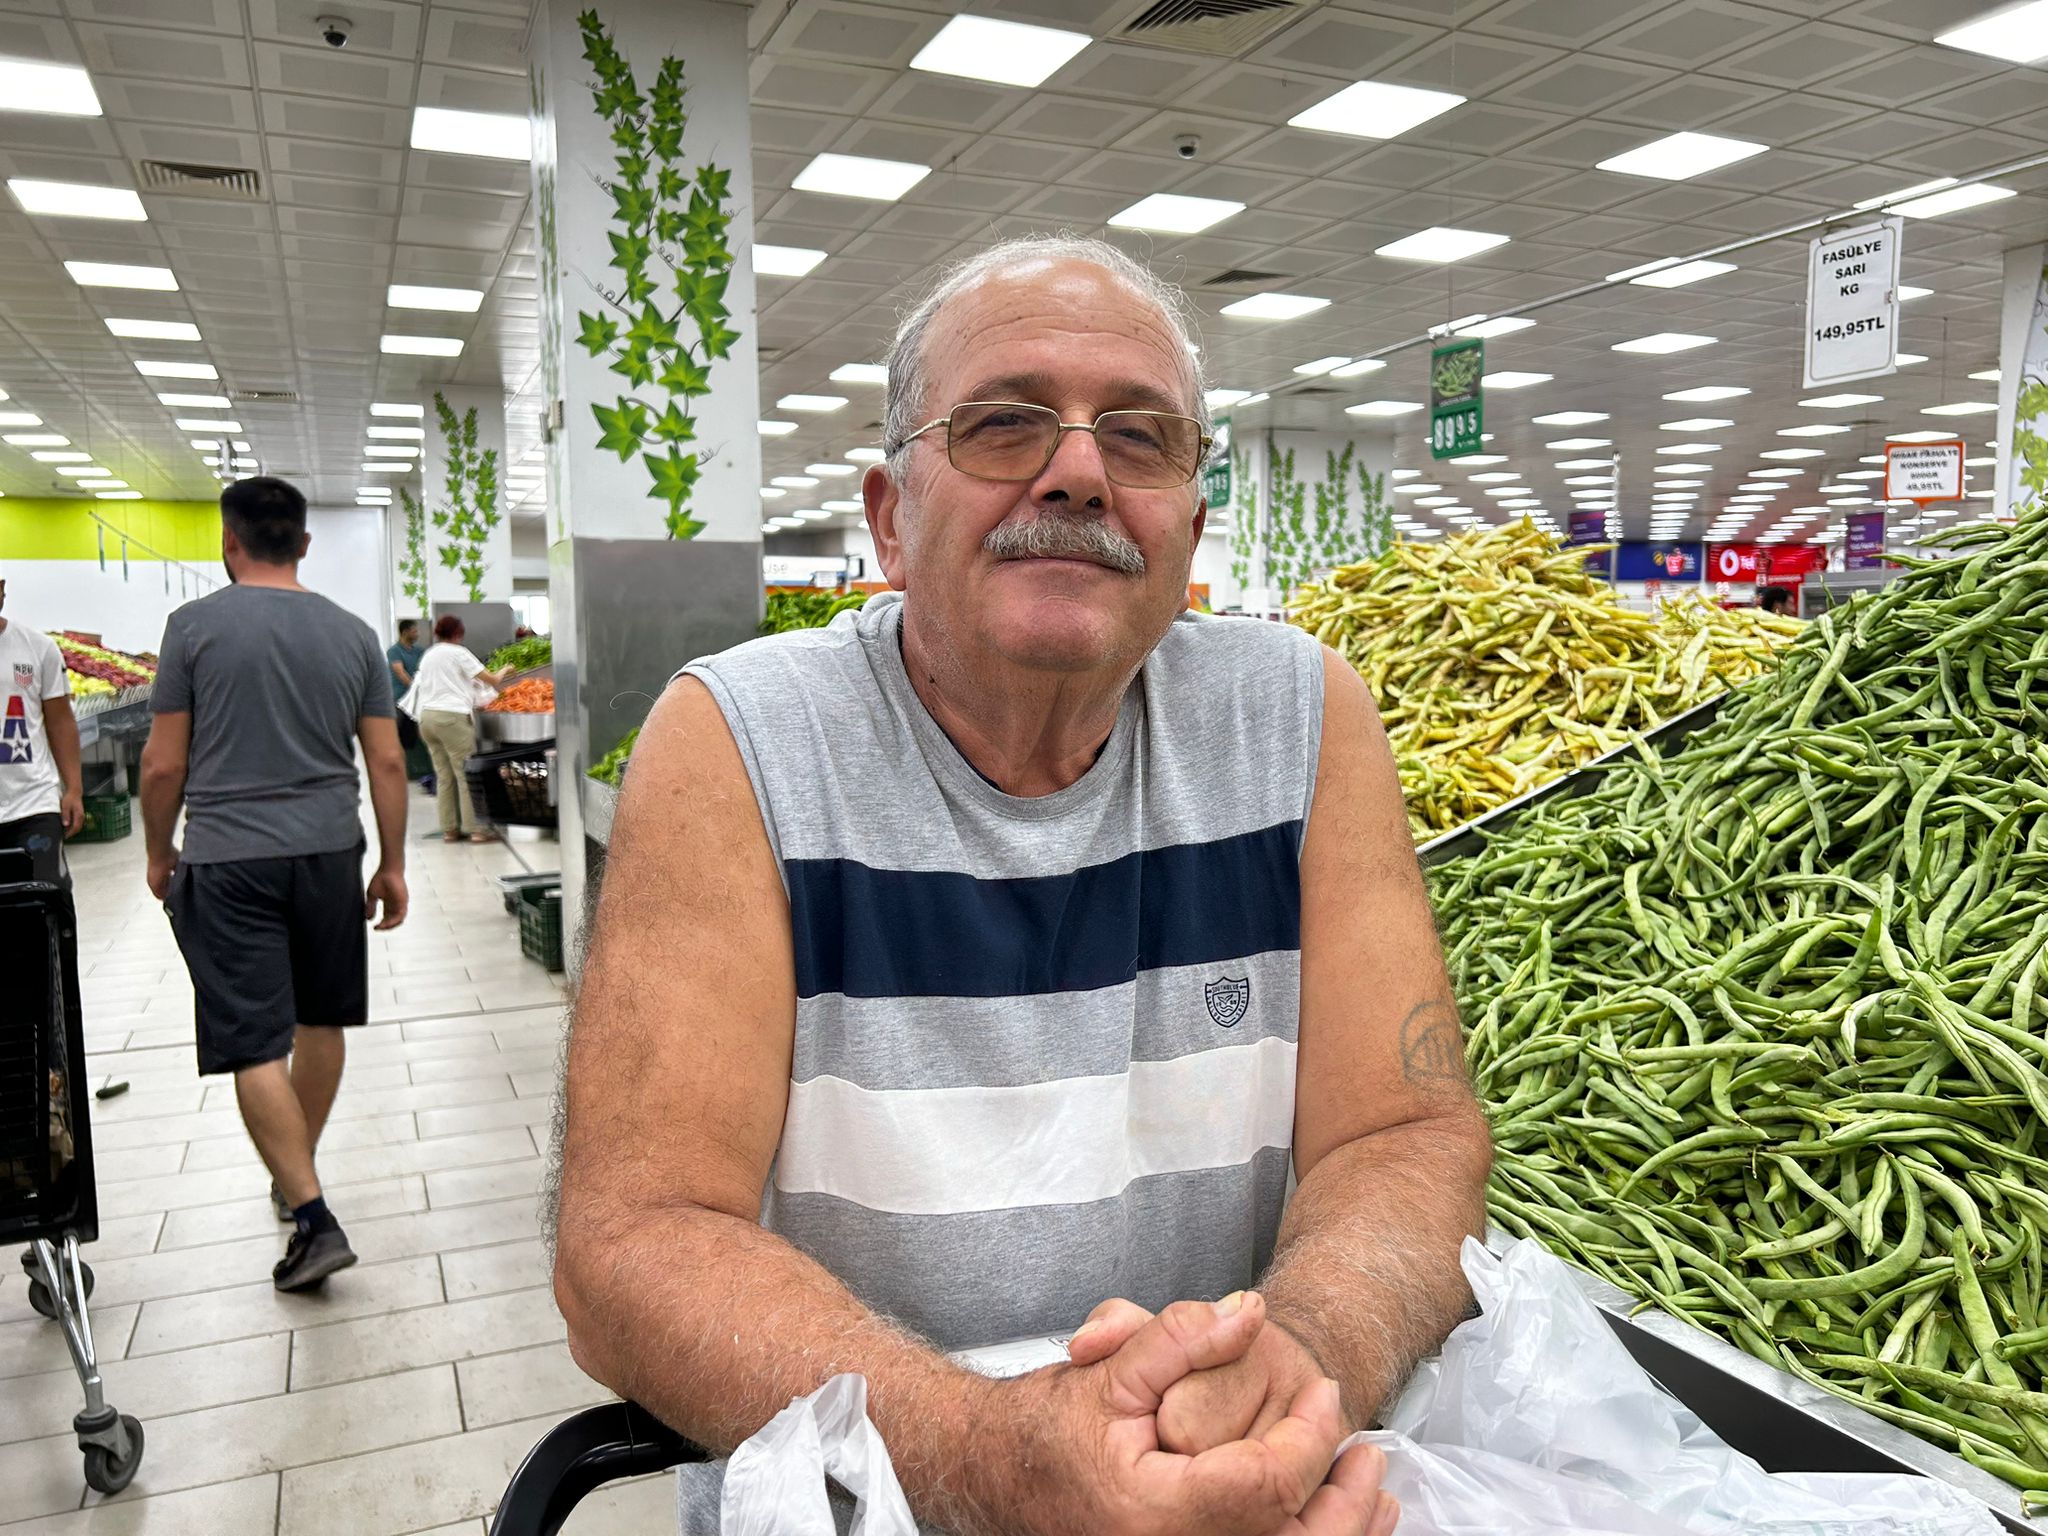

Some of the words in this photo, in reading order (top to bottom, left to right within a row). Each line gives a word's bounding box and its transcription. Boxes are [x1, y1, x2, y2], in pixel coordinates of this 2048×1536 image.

[1835, 263, 1866, 280] SARI
[1840, 283, 1859, 297] KG
[1814, 317, 1885, 342] 149,95TL
